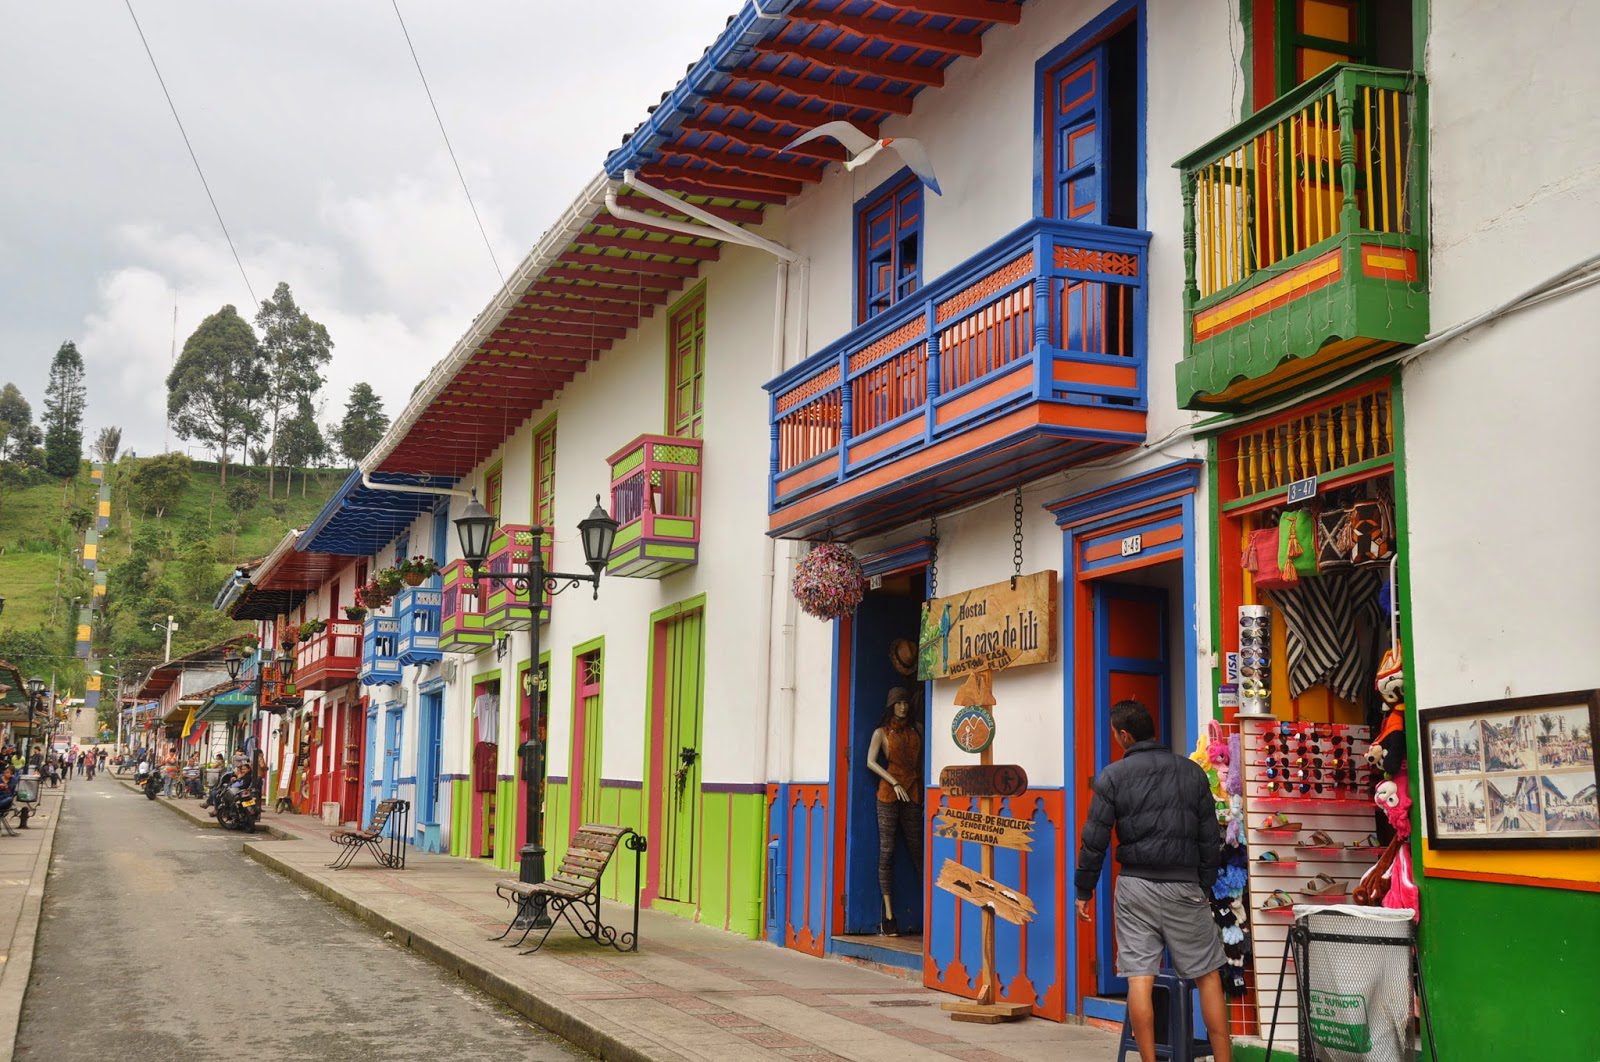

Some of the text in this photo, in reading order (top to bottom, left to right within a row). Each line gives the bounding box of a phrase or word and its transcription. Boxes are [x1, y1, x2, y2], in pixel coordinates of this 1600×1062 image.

[1291, 480, 1313, 500] 3-47
[960, 600, 986, 620] Hostal
[959, 625, 971, 660] La
[974, 629, 999, 655] casa
[1003, 615, 1017, 649] de
[986, 648, 1008, 661] CASA
[998, 655, 1012, 669] LILI
[1228, 653, 1238, 680] VISA
[945, 808, 983, 821] ALQUILER
[985, 815, 996, 825] DE
[960, 820, 1005, 835] SENDERISMO
[960, 830, 999, 844] ESCALADA
